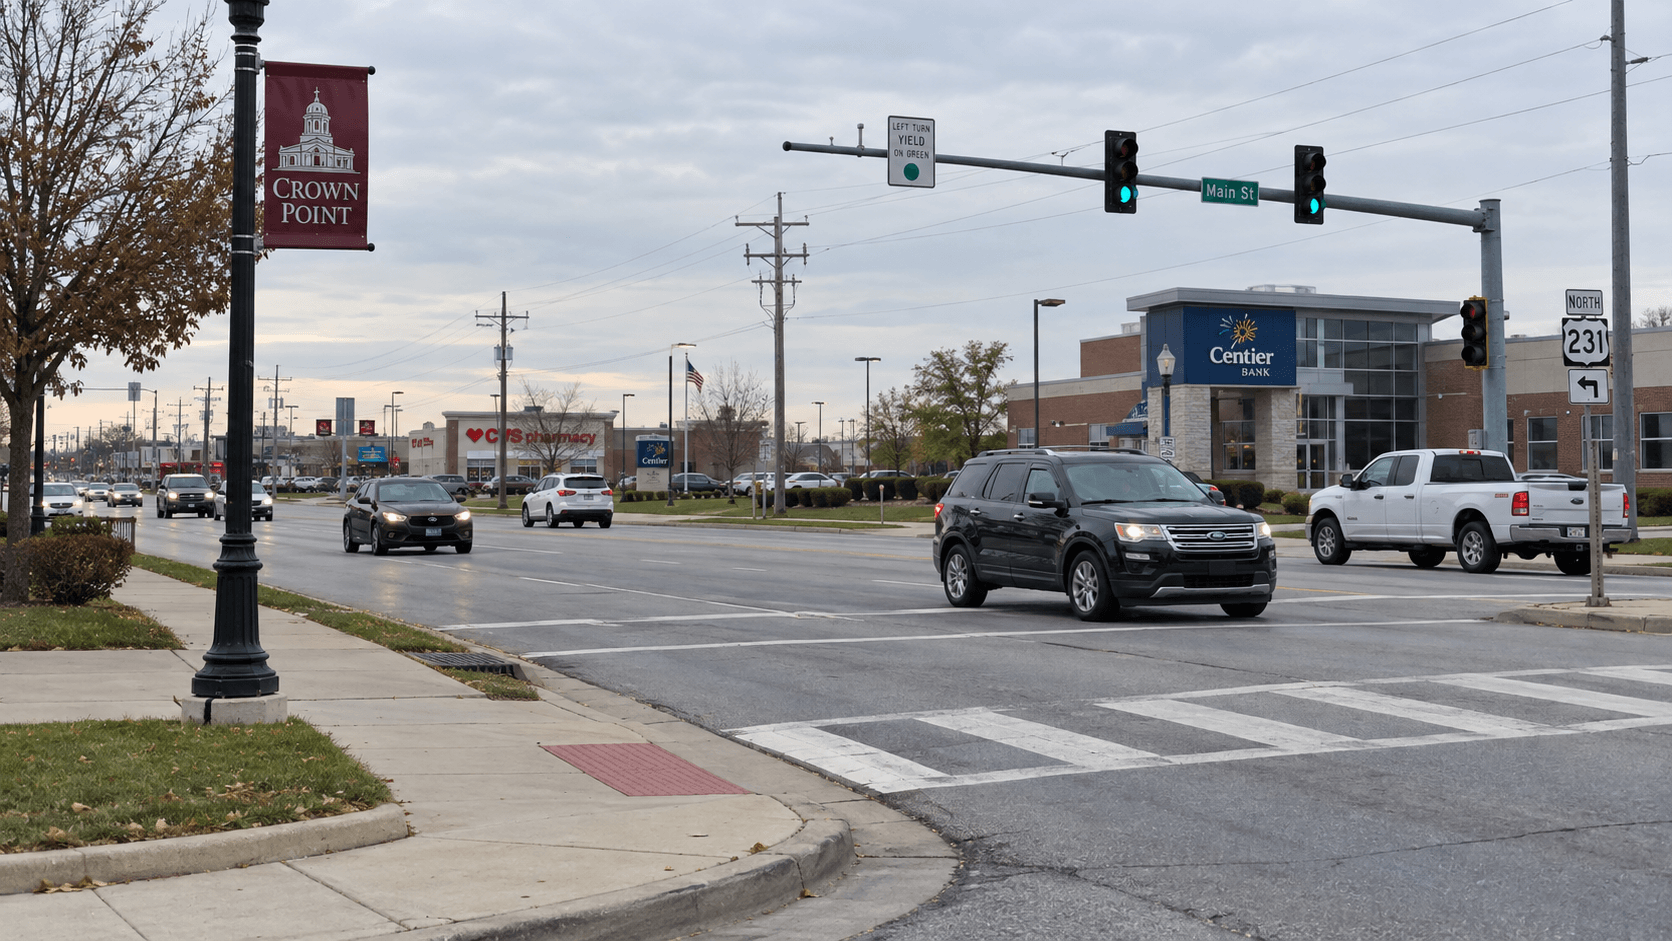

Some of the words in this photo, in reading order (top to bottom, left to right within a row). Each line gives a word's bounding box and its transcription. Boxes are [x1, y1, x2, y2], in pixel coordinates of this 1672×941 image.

[893, 122, 909, 131] LEFT
[912, 124, 930, 132] TURN
[898, 134, 925, 146] YIELD
[894, 149, 904, 157] ON
[907, 150, 930, 159] GREEN
[272, 177, 360, 201] CROWN
[1206, 183, 1236, 199] Main
[1241, 186, 1254, 201] St
[281, 202, 353, 225] POINT
[1568, 294, 1601, 309] NORTH
[1568, 329, 1604, 354] 231
[1209, 346, 1275, 365] Centier
[1241, 367, 1271, 377] BANK
[525, 430, 597, 447] pharmacy
